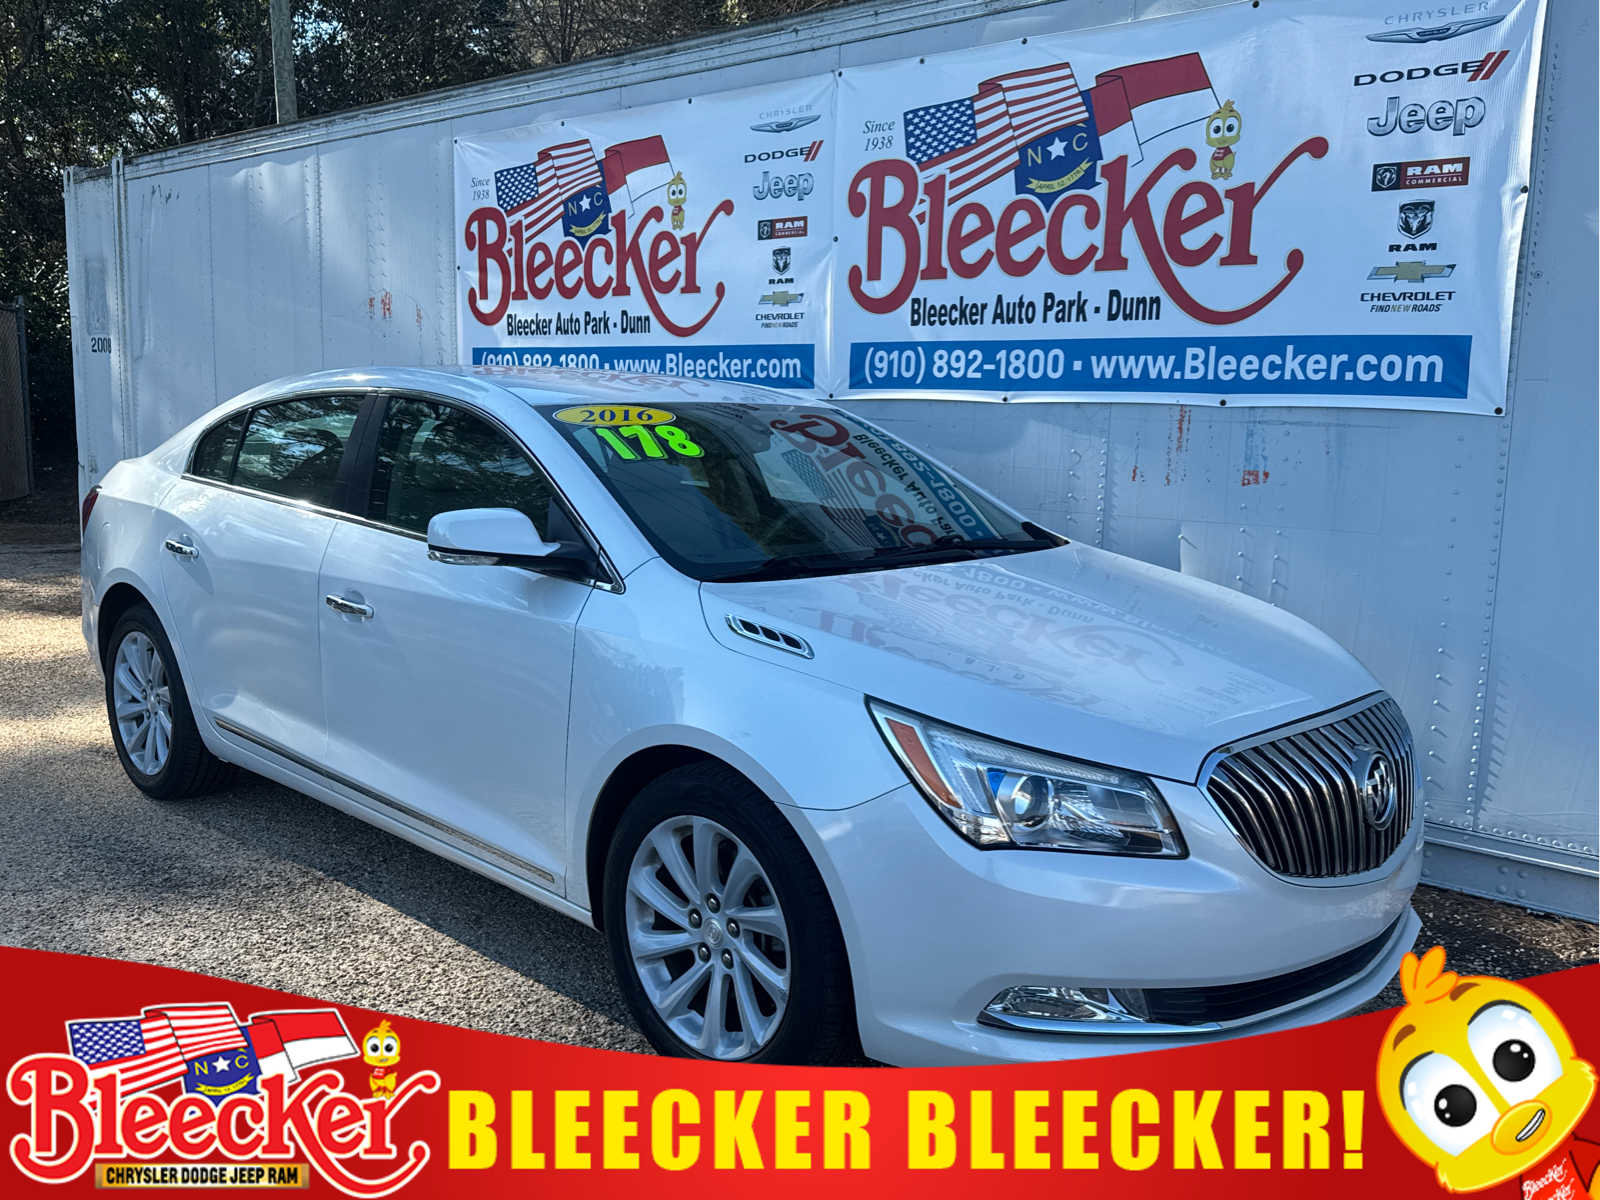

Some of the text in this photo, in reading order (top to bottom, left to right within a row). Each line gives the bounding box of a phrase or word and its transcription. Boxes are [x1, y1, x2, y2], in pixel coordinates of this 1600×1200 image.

[1384, 1, 1491, 26] CHRYSLER
[1354, 60, 1485, 87] DODGE
[1366, 96, 1486, 137] Jeep
[863, 118, 896, 135] Since
[864, 136, 895, 152] 1938
[1027, 133, 1089, 167] N C
[744, 146, 811, 164] DODGE
[1406, 162, 1464, 177] RAM
[471, 176, 491, 188] Since
[753, 170, 815, 201] Jeep
[1406, 176, 1463, 186] COMMERCIAL
[472, 188, 490, 201] 1938
[775, 220, 805, 230] RAM
[848, 136, 1329, 325] Bleecker
[1388, 242, 1438, 253] RAM
[465, 199, 735, 338] Bleecker
[768, 277, 795, 285] RAM
[1360, 291, 1457, 302] CHEVROLET
[756, 312, 806, 321] CHEVROLET
[910, 296, 988, 327] Bleecker
[992, 294, 1036, 325] Auto
[1042, 290, 1089, 323] Park
[1107, 289, 1161, 322] Dunn
[506, 314, 553, 337] Bleecker
[555, 312, 581, 336] Auto
[584, 311, 611, 335] Park
[621, 310, 651, 334] Dunn
[614, 352, 801, 379] www.Bleecker.com
[864, 345, 1444, 386] (910) 892-1800 www.Bleecker.com
[580, 409, 653, 422] 2016
